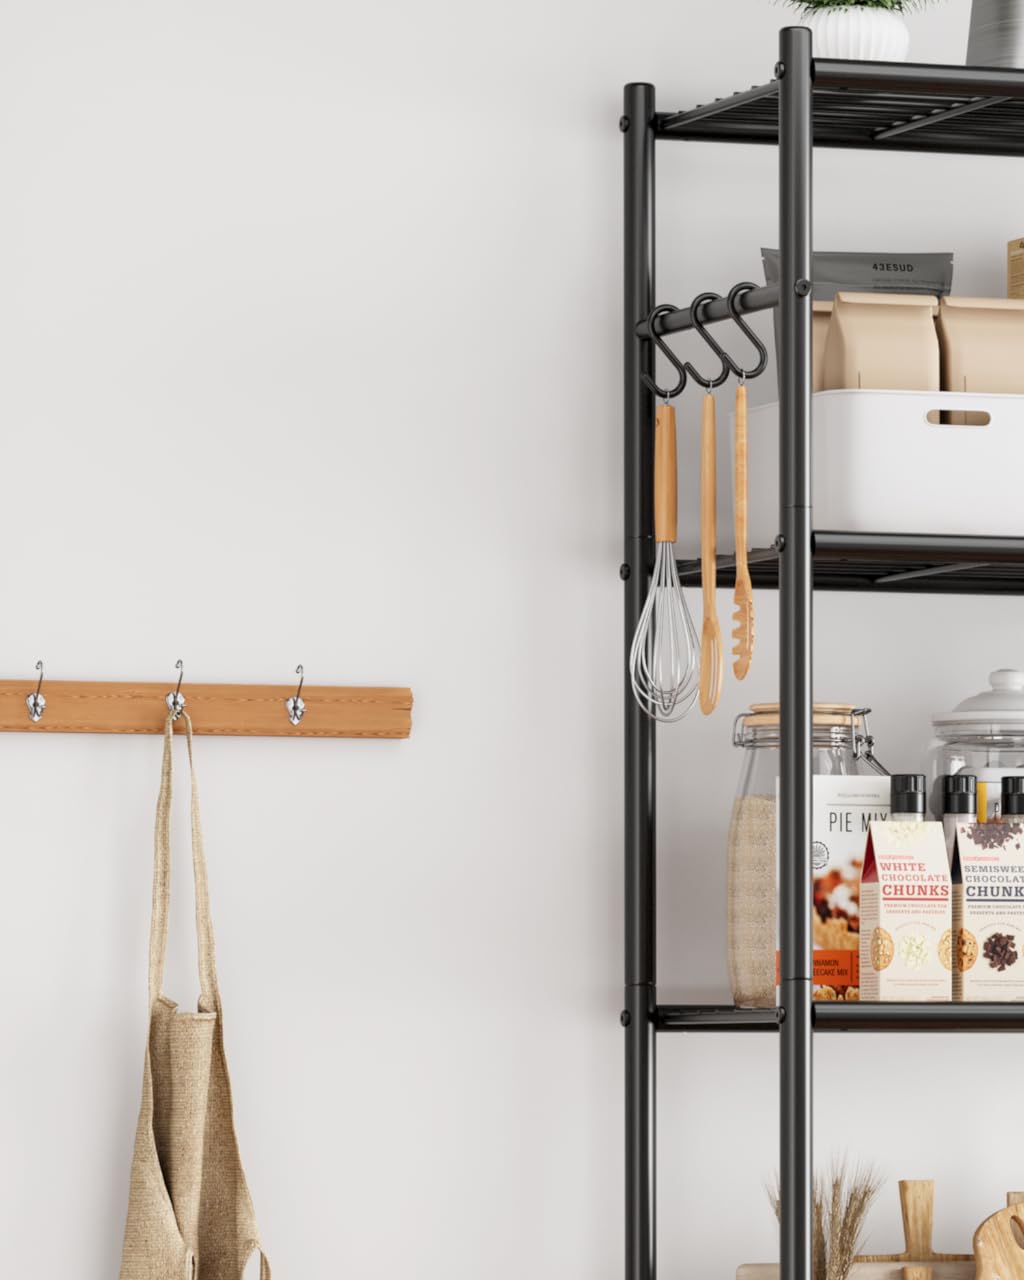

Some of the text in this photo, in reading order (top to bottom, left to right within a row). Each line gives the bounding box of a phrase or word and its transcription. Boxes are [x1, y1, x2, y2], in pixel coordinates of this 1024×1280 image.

[829, 812, 853, 832] PIE
[880, 862, 926, 872] WHITE
[881, 873, 949, 882] CHOCOLATE
[882, 884, 949, 896] CHUNKS
